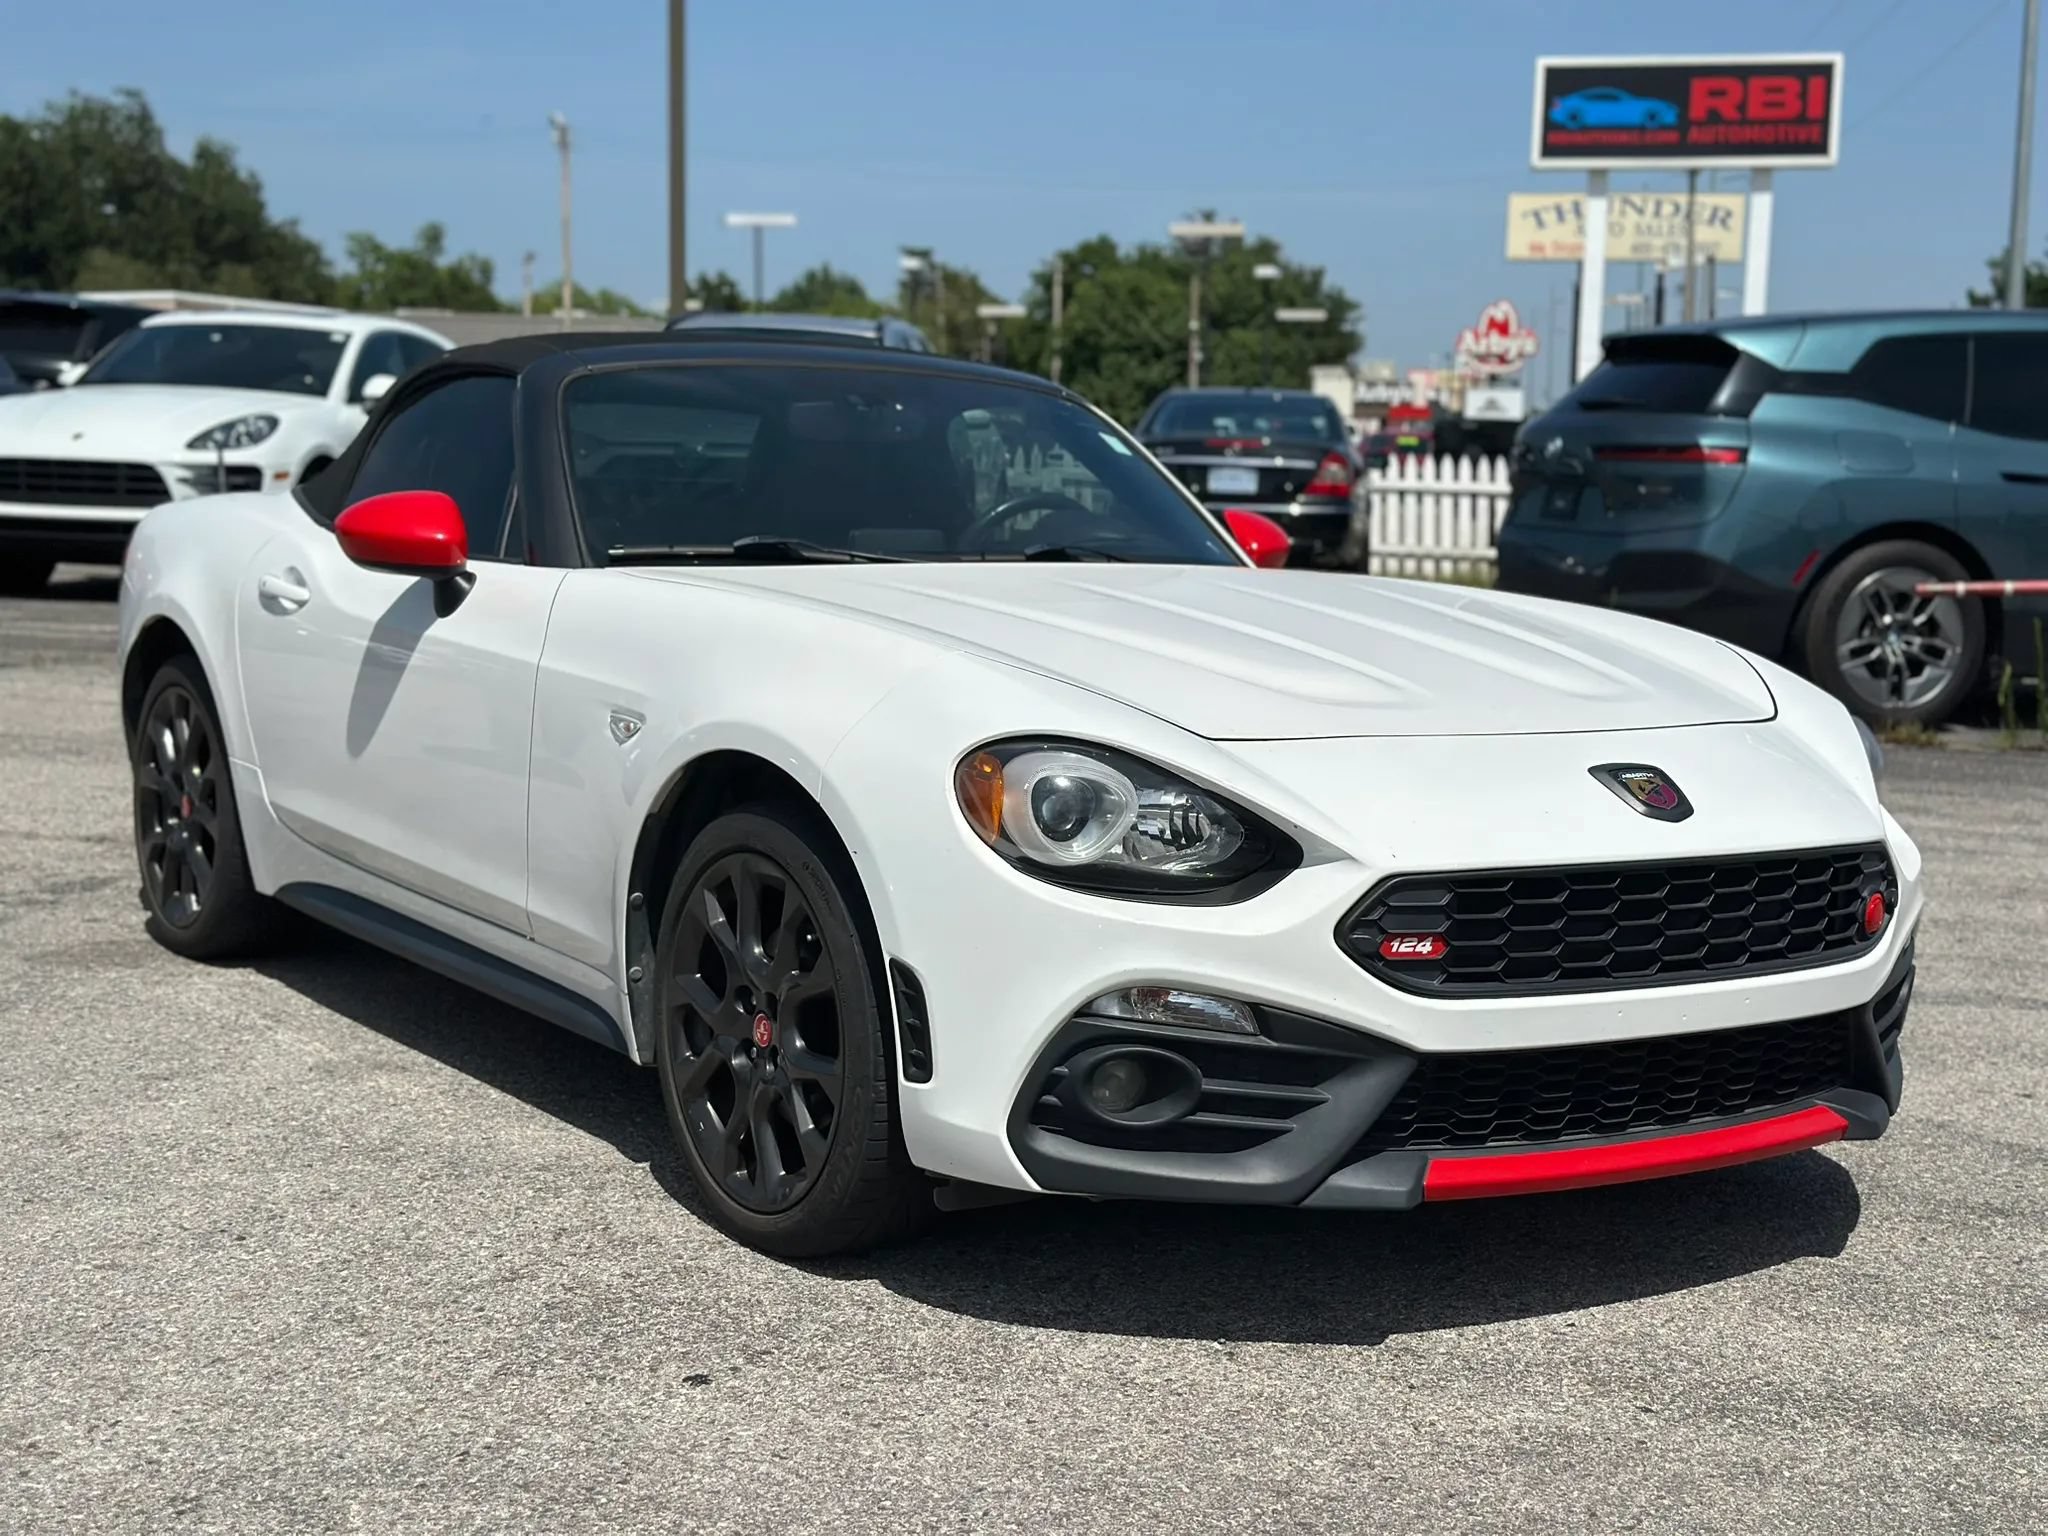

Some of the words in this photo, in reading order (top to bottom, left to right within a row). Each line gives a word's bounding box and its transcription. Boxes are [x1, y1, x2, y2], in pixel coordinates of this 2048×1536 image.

[1688, 76, 1827, 121] RBI
[1688, 125, 1821, 145] AUTOMOTIVE
[1521, 196, 1734, 231] THNDER
[1390, 937, 1433, 954] 124
